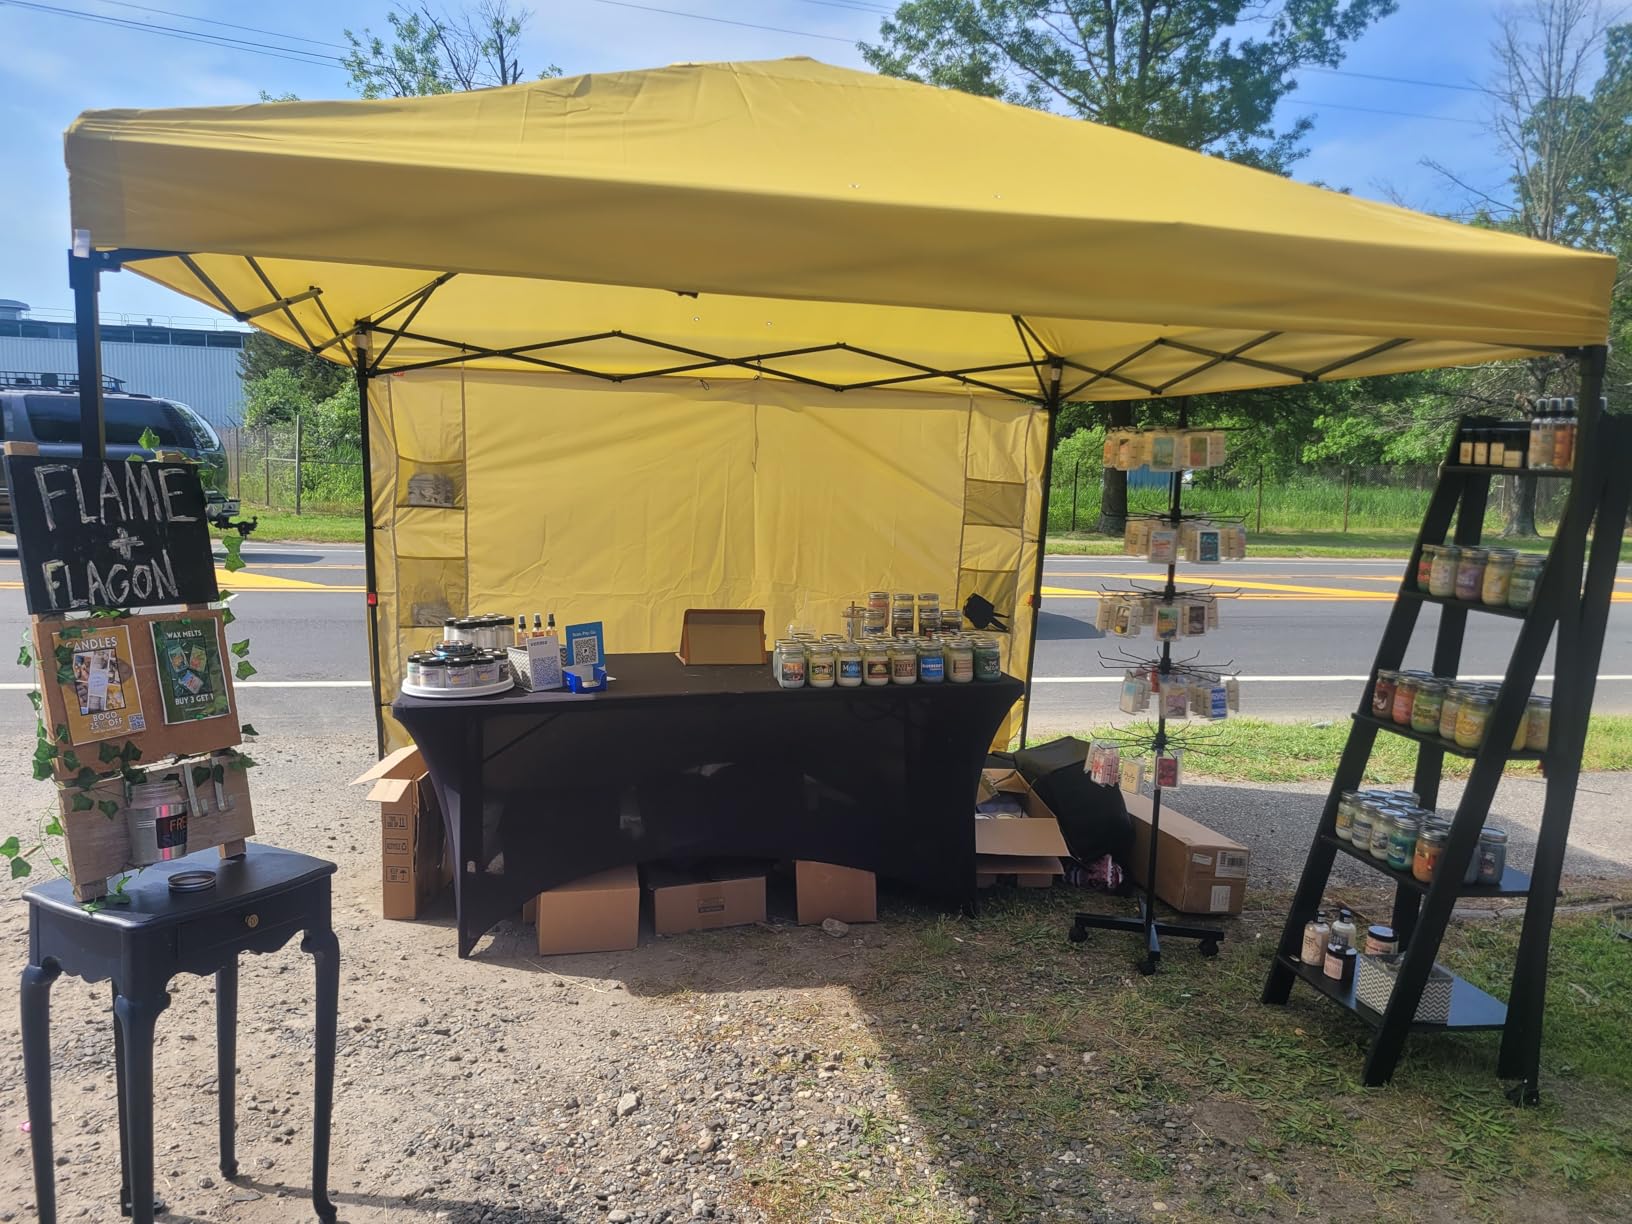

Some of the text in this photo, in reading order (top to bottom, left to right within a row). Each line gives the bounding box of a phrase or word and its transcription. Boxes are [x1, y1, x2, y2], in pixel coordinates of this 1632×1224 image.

[33, 462, 200, 532] FLAME
[41, 549, 179, 611] FLAGON
[183, 629, 203, 638] MELTS
[175, 697, 189, 706] BUY
[196, 694, 209, 703] GET
[92, 711, 118, 722] BOGO
[108, 717, 123, 727] OFF
